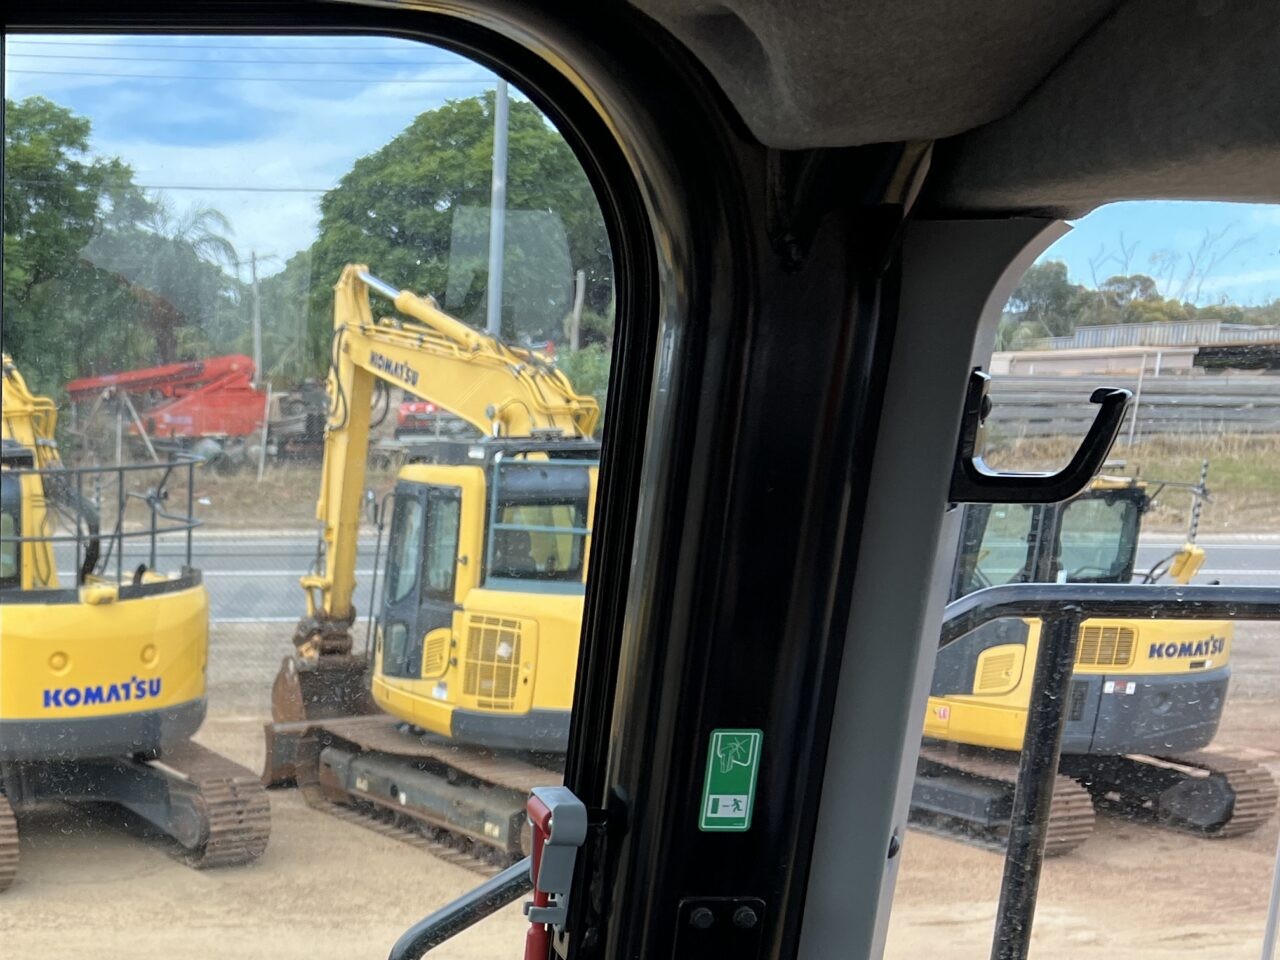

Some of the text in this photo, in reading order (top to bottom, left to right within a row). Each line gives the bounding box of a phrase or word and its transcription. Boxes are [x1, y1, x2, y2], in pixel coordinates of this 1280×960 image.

[370, 351, 419, 386] KOMATSU
[1148, 634, 1226, 659] KOMATSU
[42, 675, 162, 708] KOMATSU
